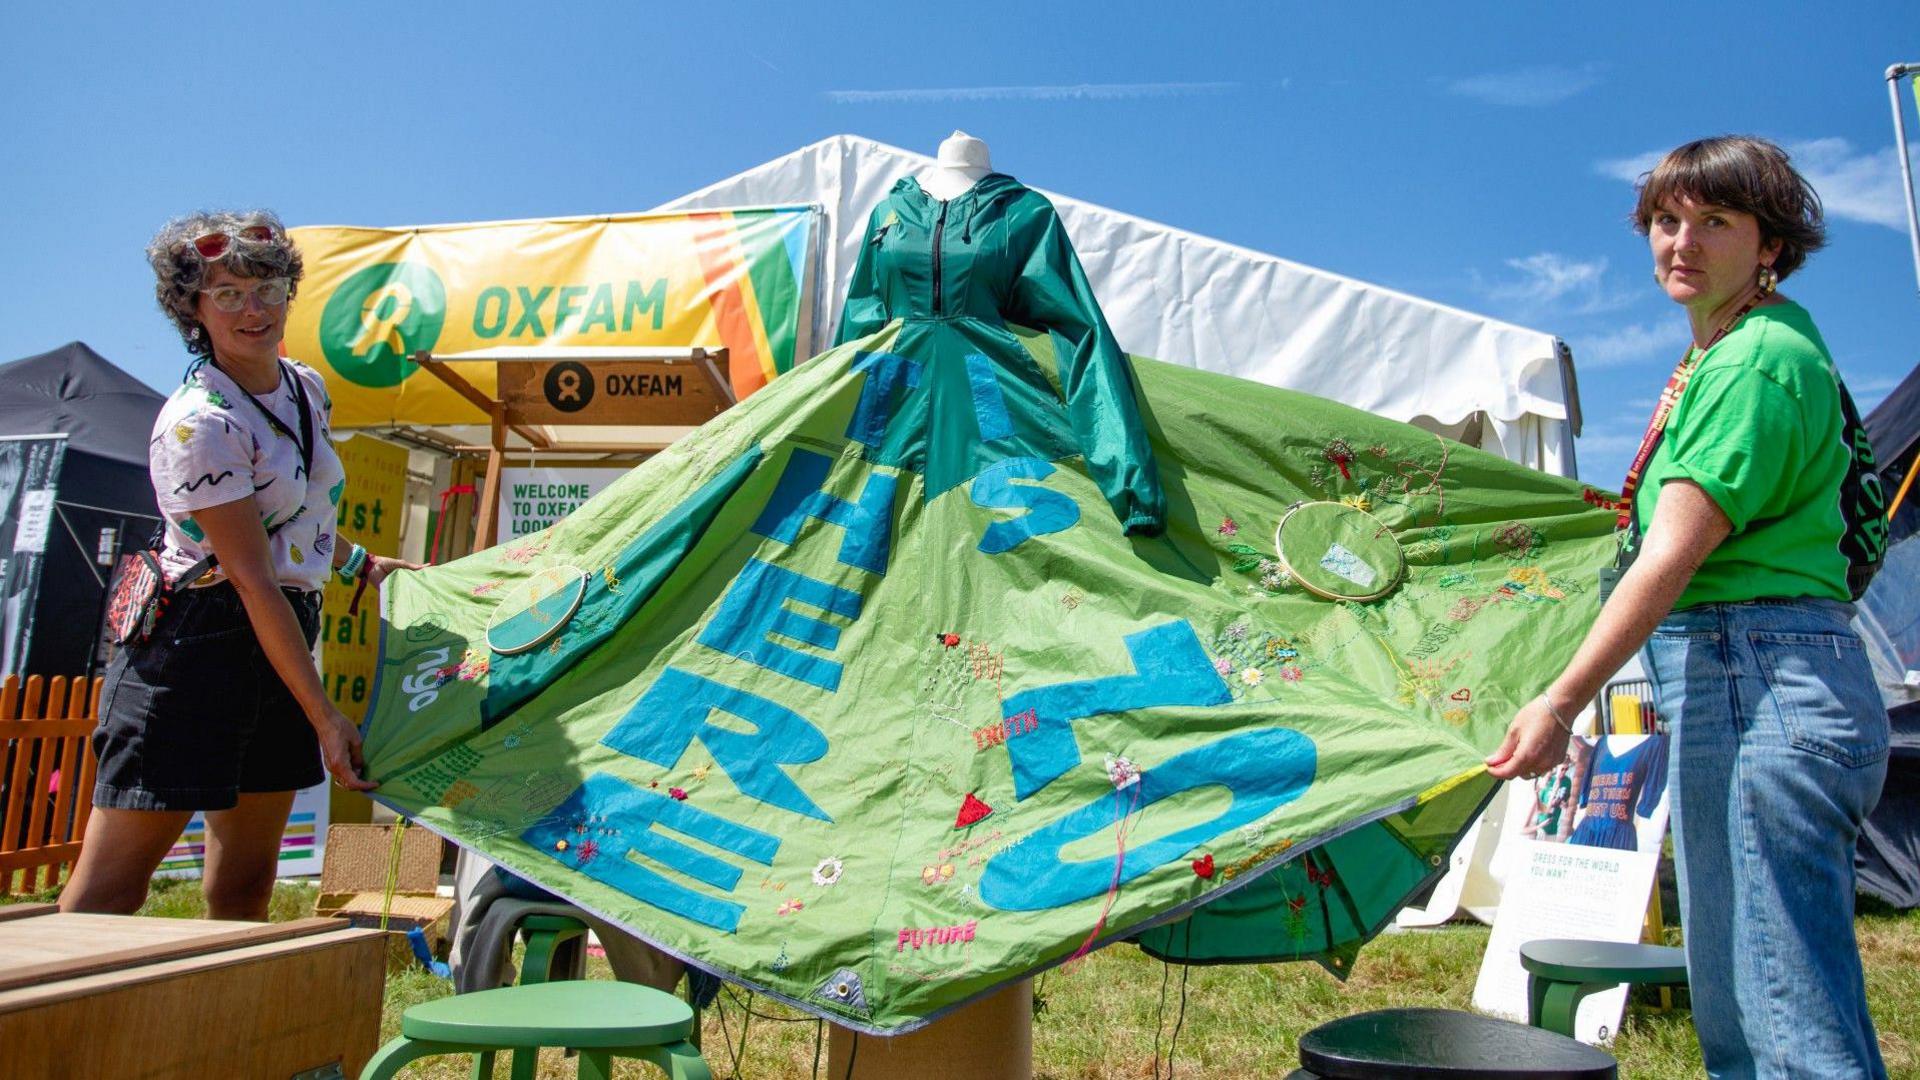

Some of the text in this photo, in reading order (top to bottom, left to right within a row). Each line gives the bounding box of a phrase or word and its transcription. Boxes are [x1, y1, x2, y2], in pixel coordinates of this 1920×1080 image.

[472, 278, 669, 339] OXFAM
[606, 374, 683, 397] OXFAM
[513, 484, 589, 499] WELCOME
[513, 501, 584, 516] TO OXFA
[971, 707, 1039, 750] TRUTH
[1531, 866, 1568, 880] YOU WANT
[1533, 852, 1620, 873] DRESS FOR THE WORLD
[897, 919, 978, 952] FUTURE
